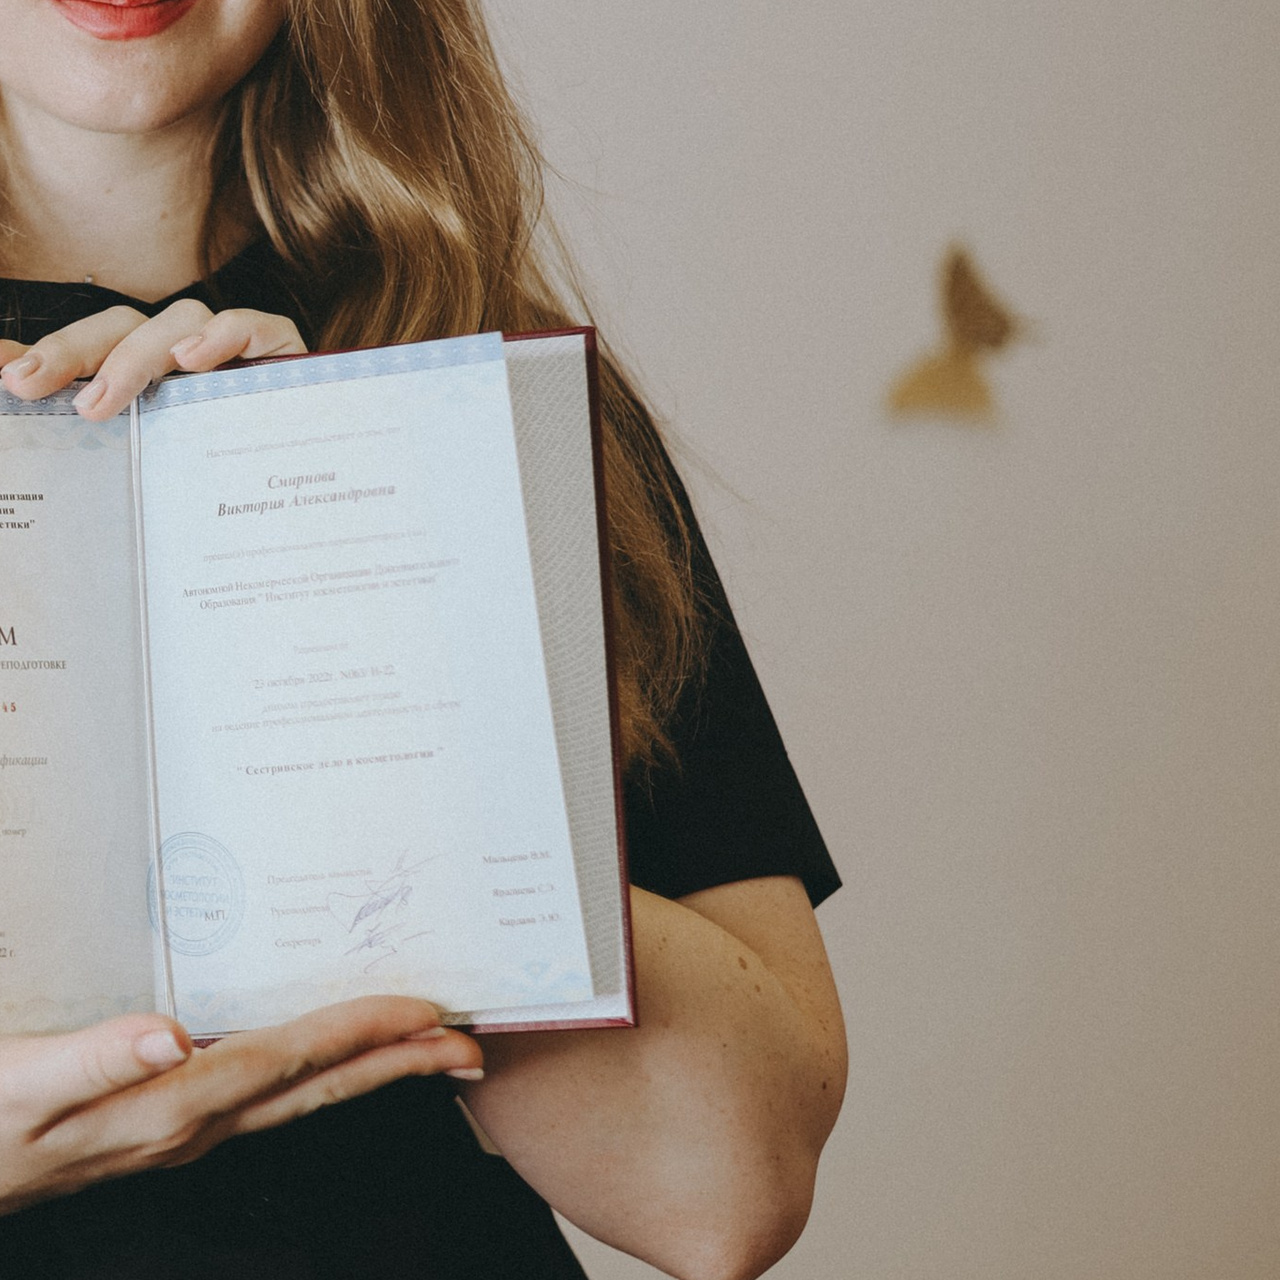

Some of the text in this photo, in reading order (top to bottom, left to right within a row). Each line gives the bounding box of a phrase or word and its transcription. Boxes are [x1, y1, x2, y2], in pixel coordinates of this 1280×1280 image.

[267, 471, 336, 489] Смирнова
[217, 485, 396, 517] Виктория Александровна
